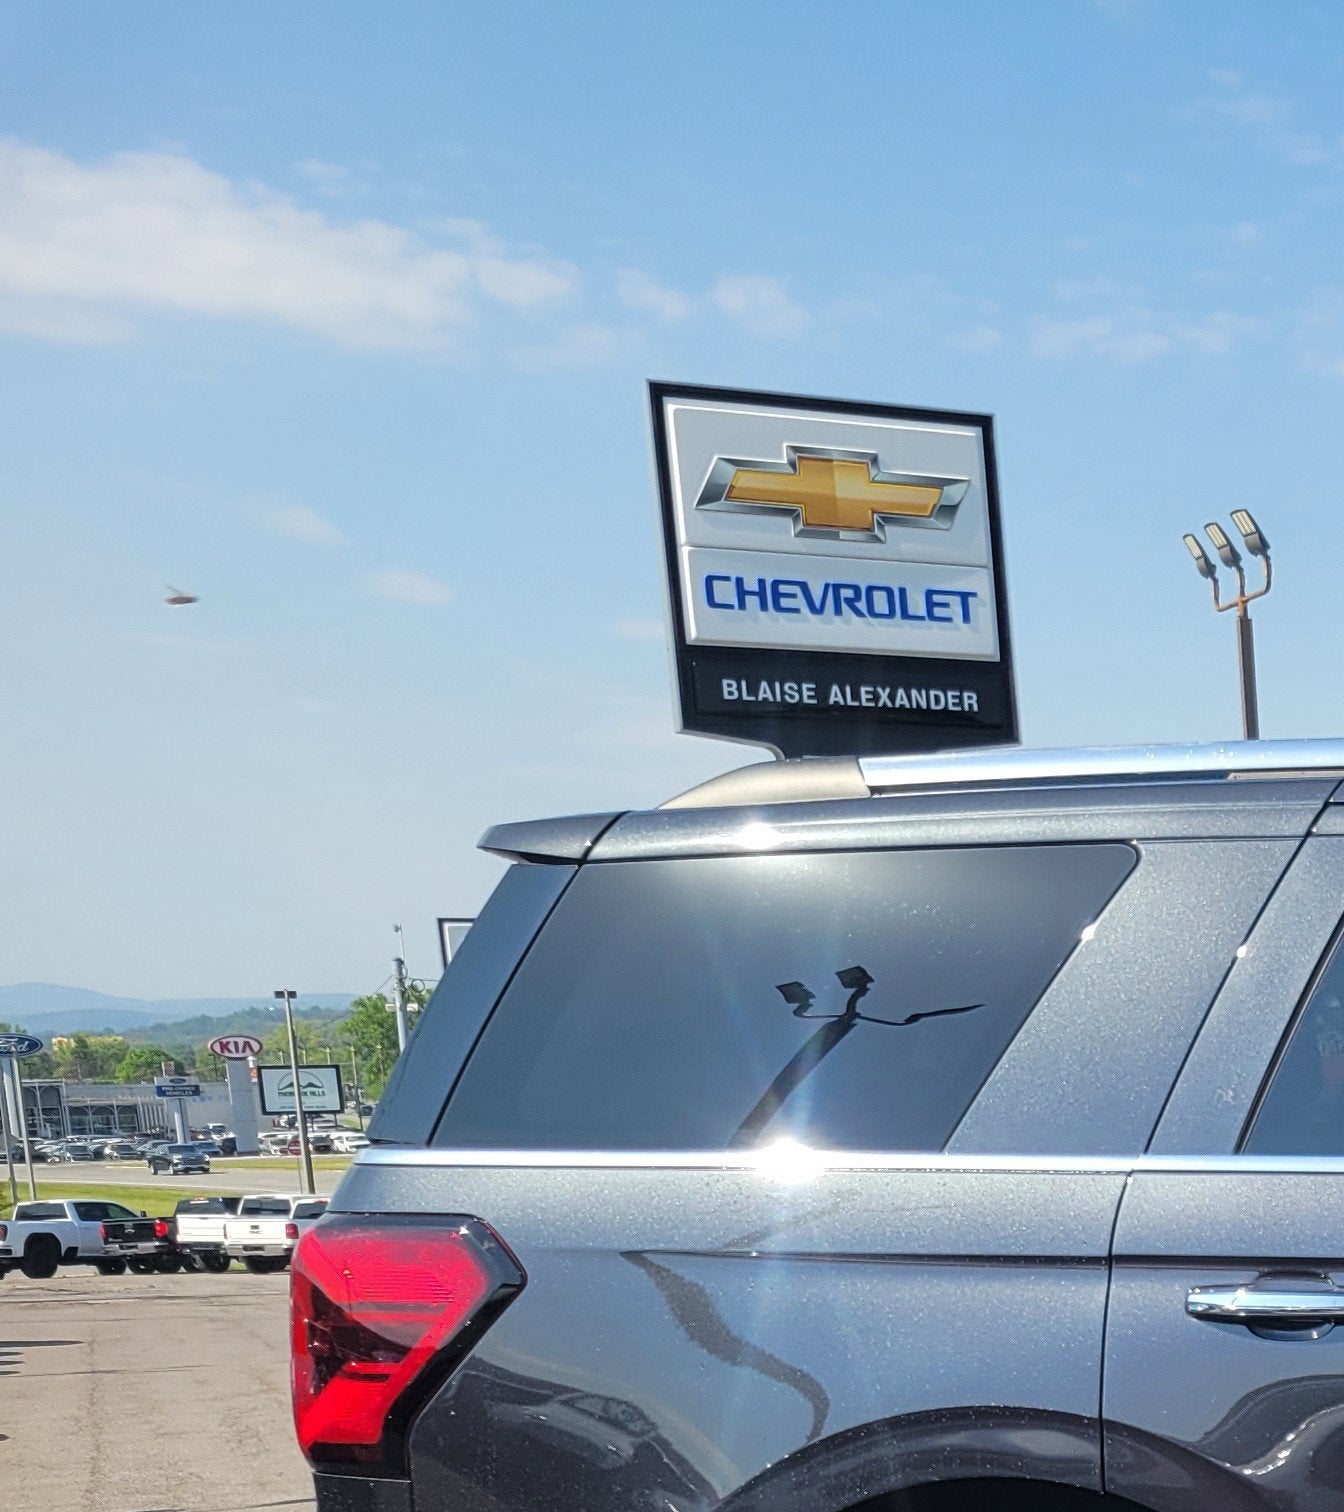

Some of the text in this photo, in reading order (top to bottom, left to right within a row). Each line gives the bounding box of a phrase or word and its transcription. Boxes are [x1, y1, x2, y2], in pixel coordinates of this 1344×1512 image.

[704, 573, 978, 625] CHEVROLET
[721, 678, 979, 713] BLAISE ALEXANDER
[218, 1040, 256, 1054] KIA
